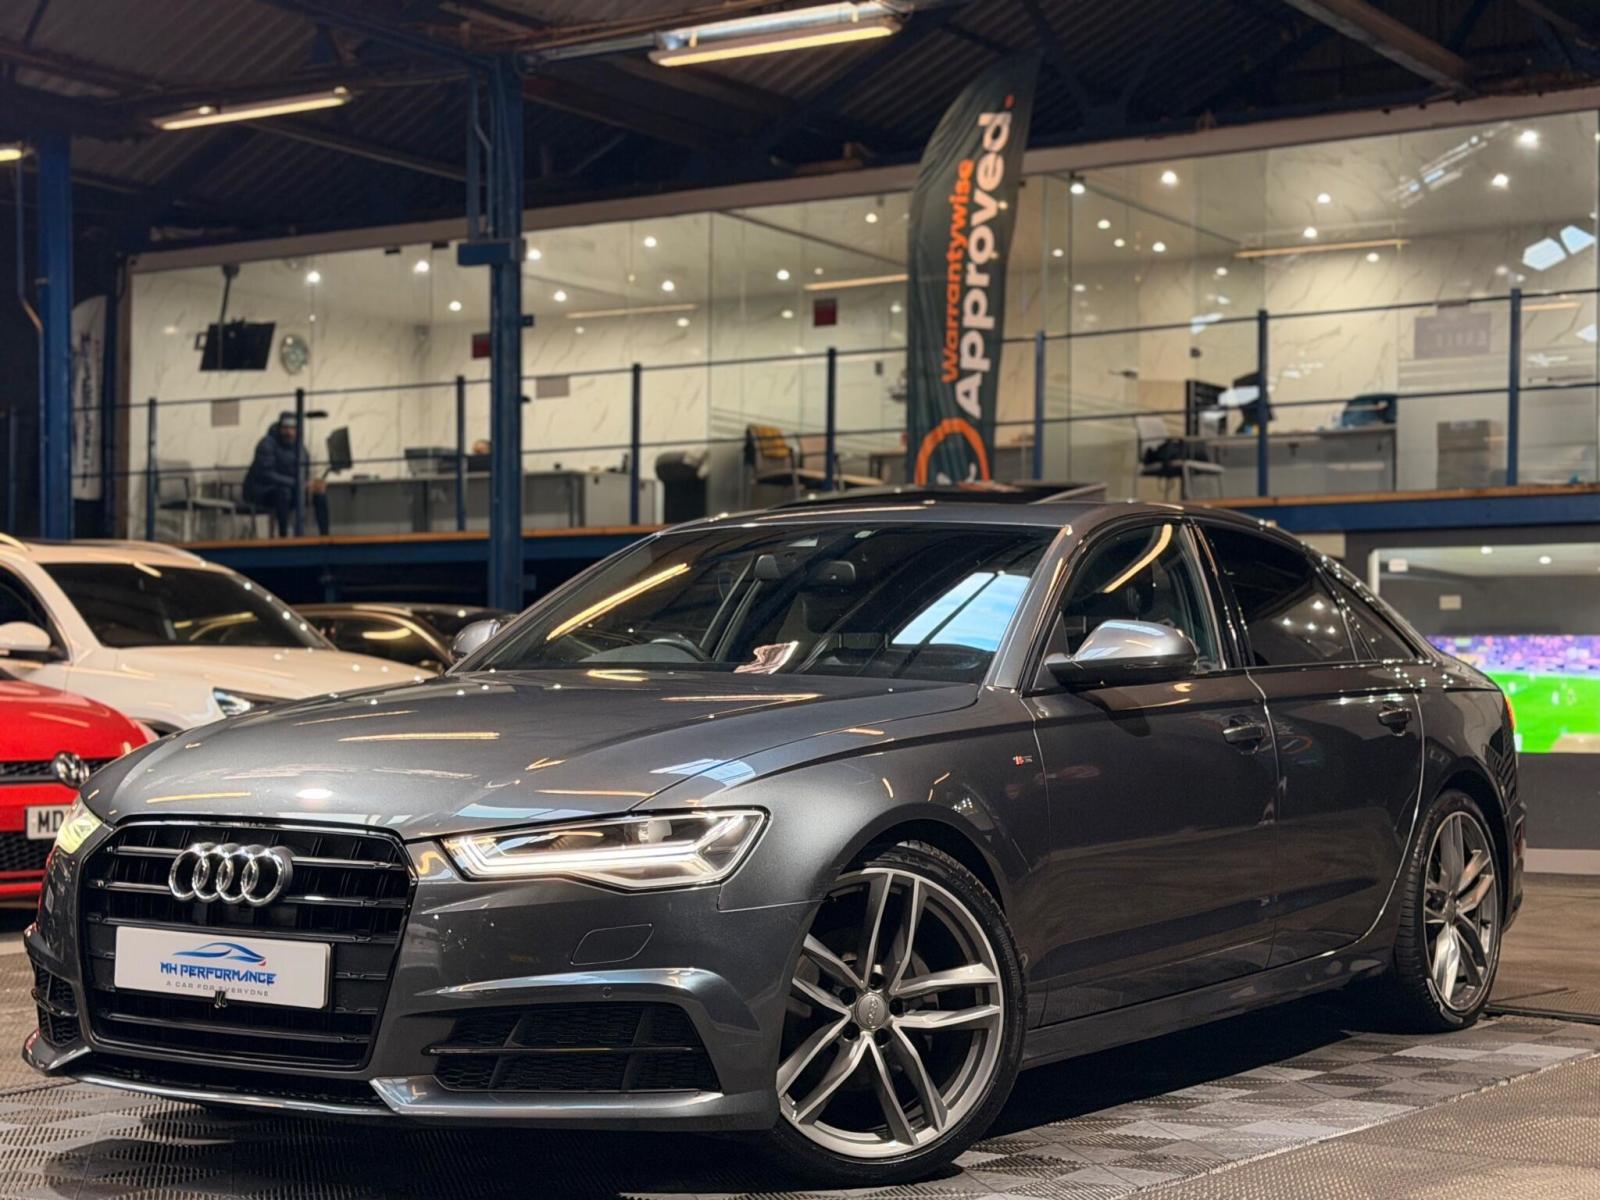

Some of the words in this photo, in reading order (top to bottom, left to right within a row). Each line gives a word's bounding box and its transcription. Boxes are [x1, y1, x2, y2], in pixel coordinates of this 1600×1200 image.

[941, 158, 974, 381] Warrantywise
[160, 962, 178, 975] MH
[180, 964, 276, 985] PERFORMANCE
[218, 986, 269, 996] EVERYONE
